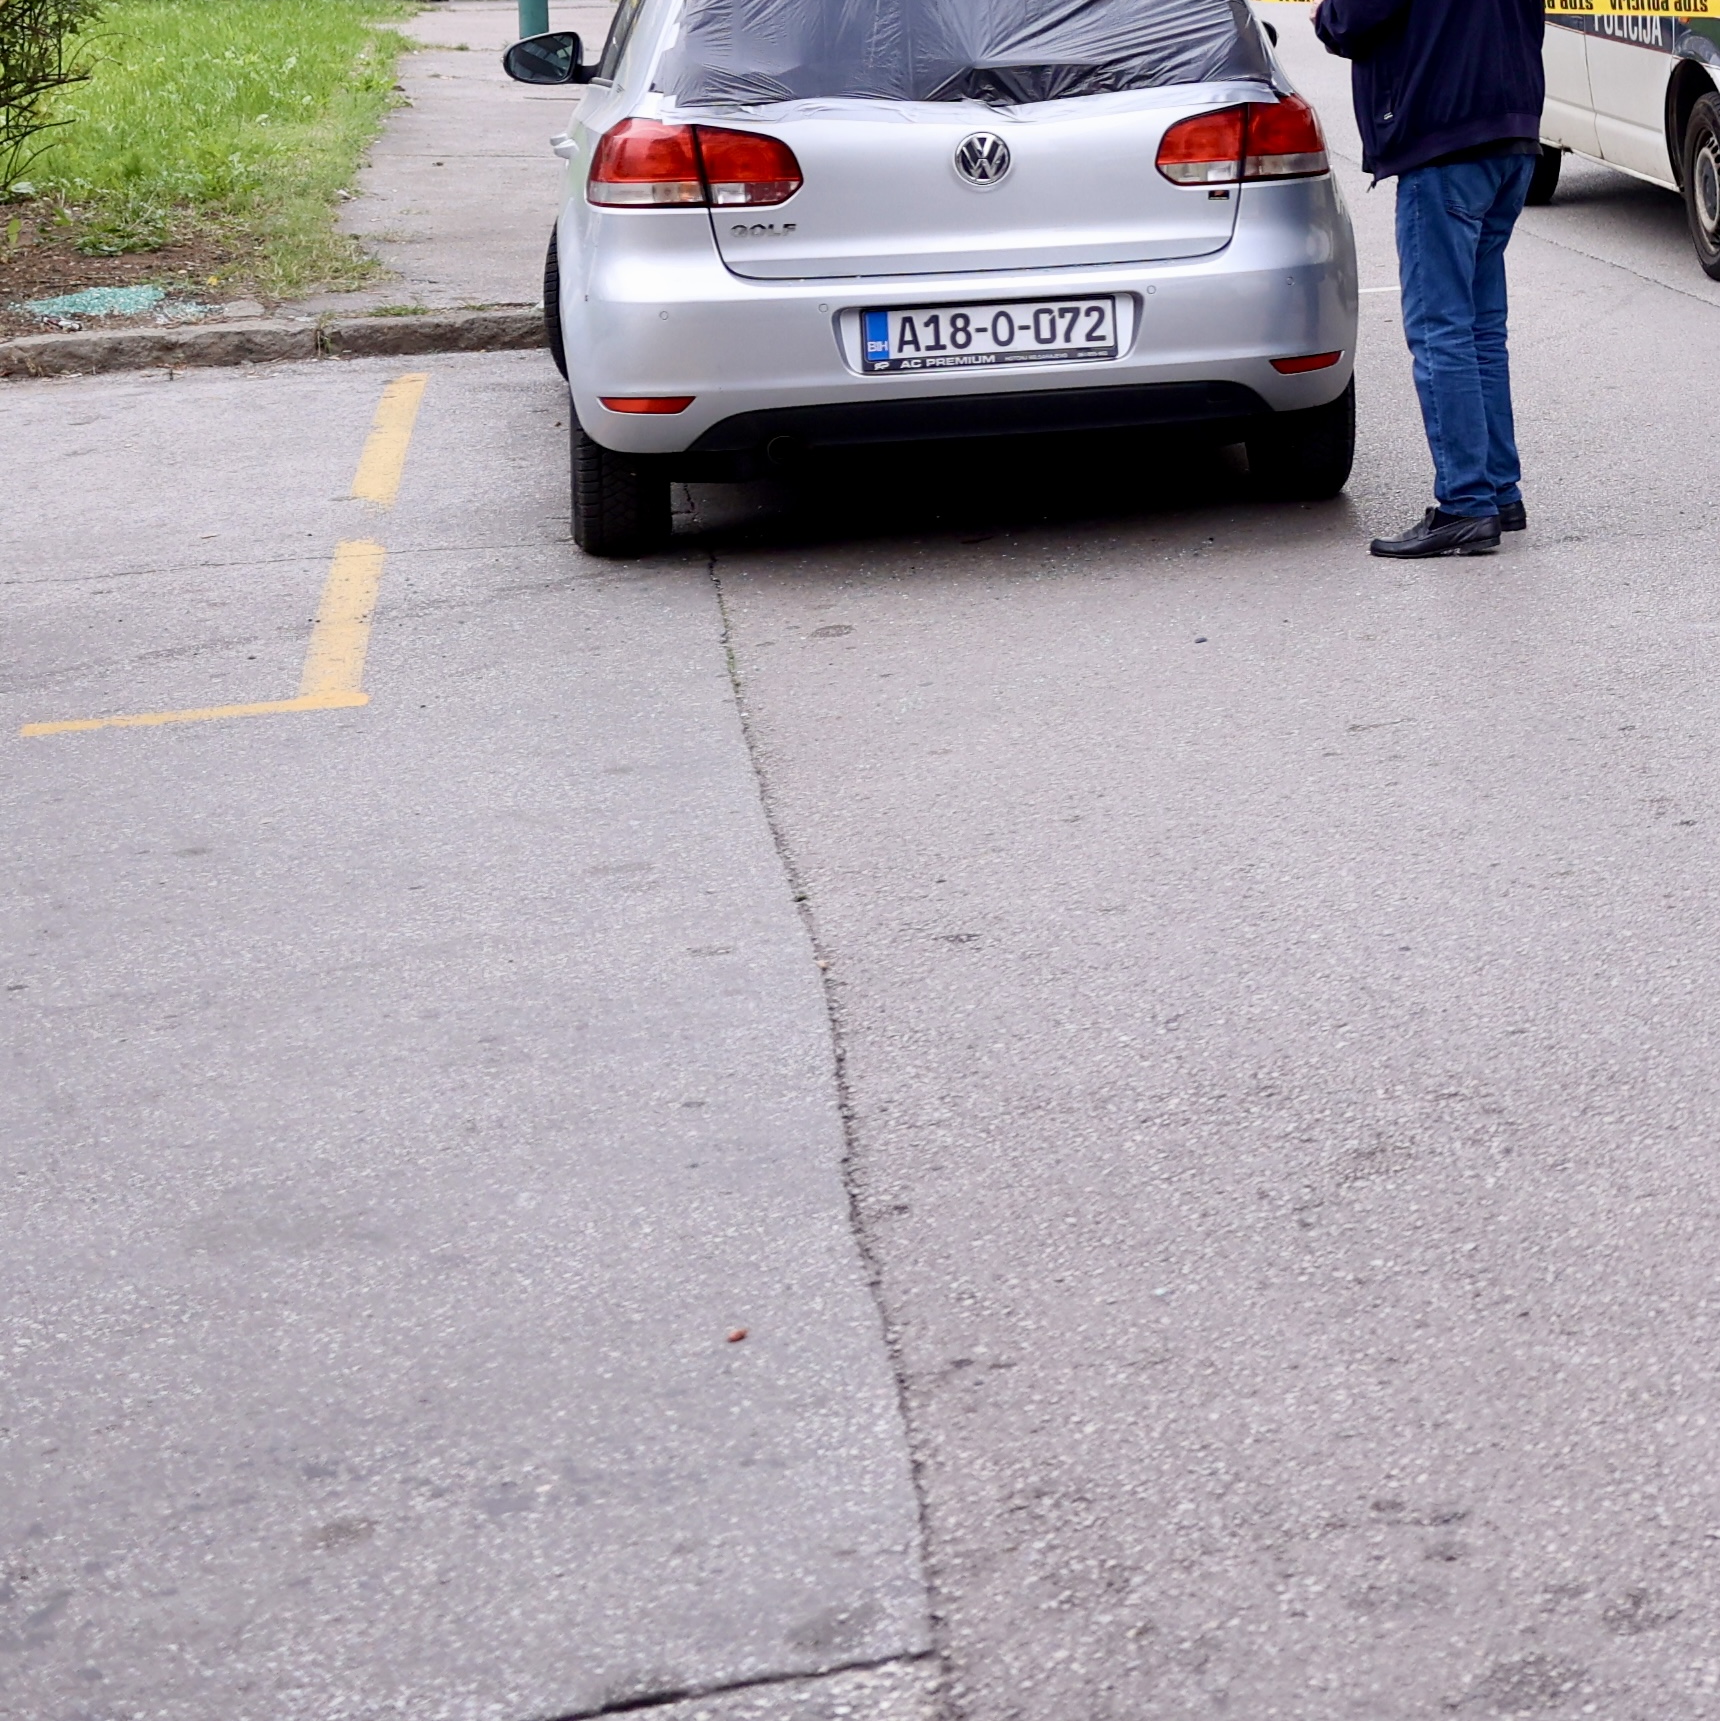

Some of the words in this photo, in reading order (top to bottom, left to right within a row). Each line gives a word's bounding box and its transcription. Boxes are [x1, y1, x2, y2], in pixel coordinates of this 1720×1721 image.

[730, 223, 797, 237] GOLF
[867, 340, 888, 353] BIH
[897, 305, 1107, 353] A18-O-072
[900, 359, 922, 369] AC
[925, 354, 996, 368] PREMIUM
